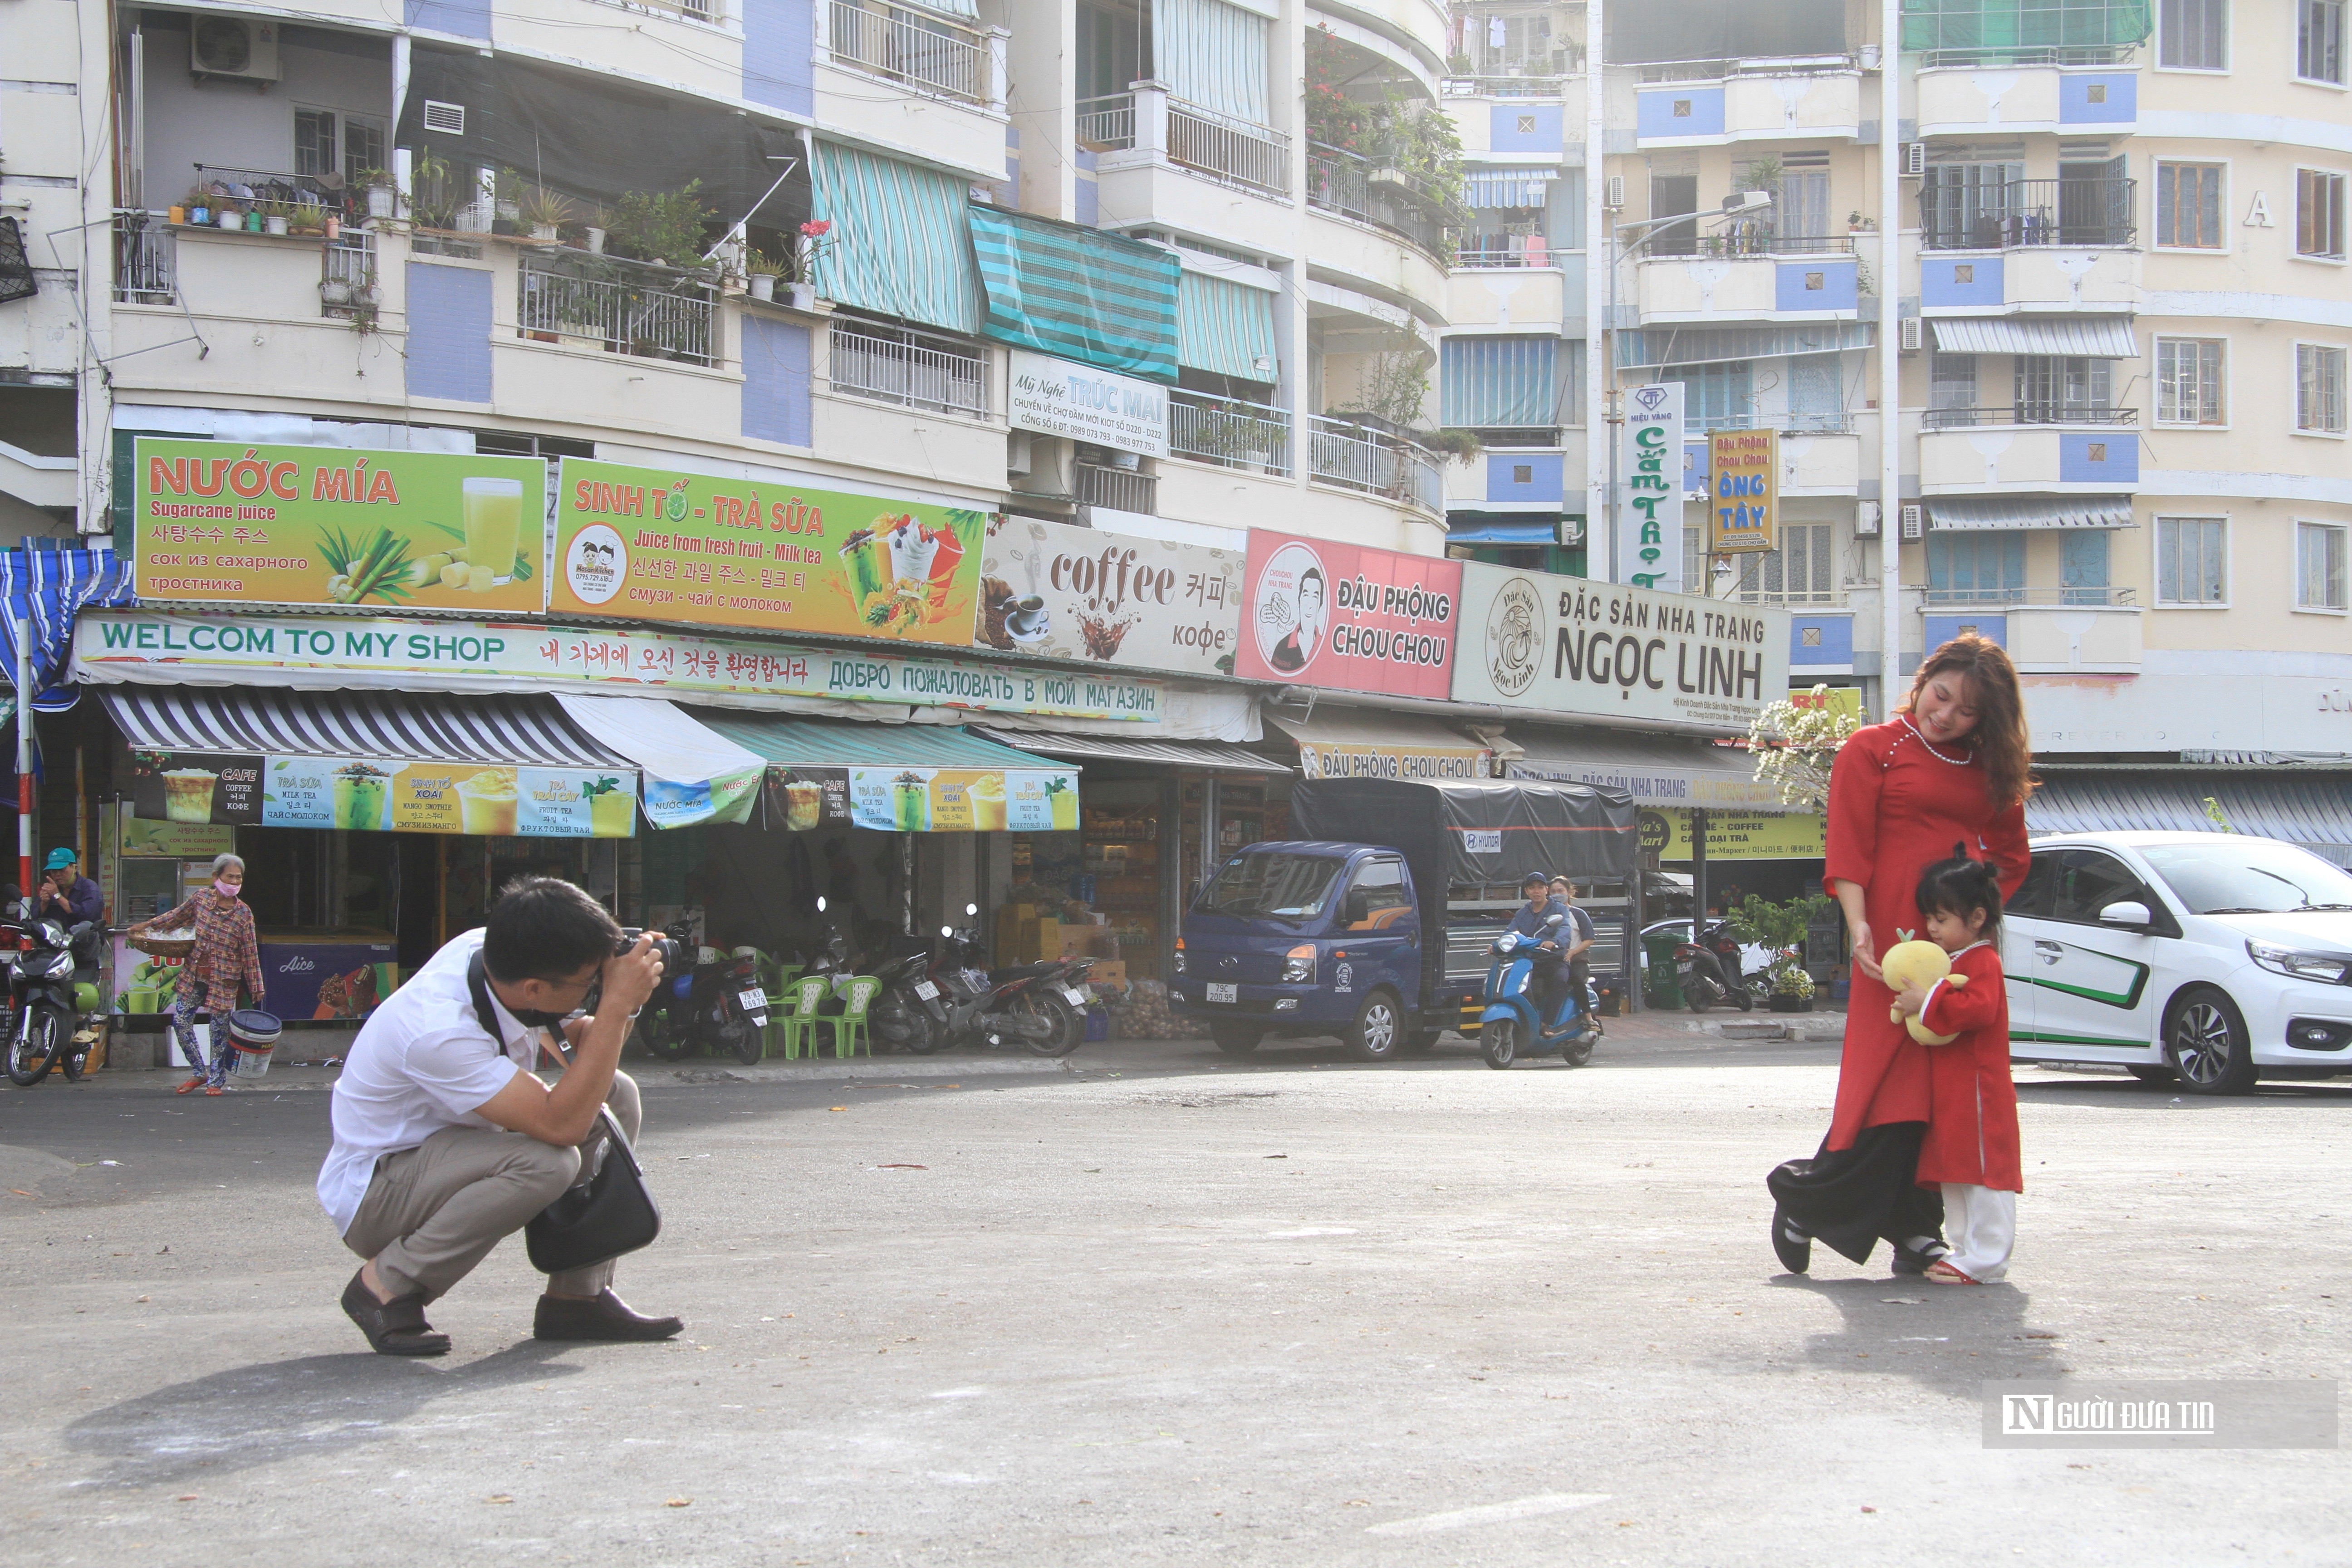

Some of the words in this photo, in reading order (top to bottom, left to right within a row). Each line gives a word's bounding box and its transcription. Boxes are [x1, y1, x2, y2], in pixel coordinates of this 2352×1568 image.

[2243, 190, 2275, 228] A
[1015, 374, 1035, 394] Mỹ
[1038, 380, 1066, 400] Nghệ
[1068, 376, 1117, 413] TRÚC
[1123, 389, 1161, 424] MAI
[1014, 397, 1042, 412] CHUYỂN
[1044, 402, 1052, 413] VỀ
[1053, 407, 1067, 418] CHỢ
[1069, 408, 1084, 420] ĐẦM
[1086, 413, 1099, 424] MỚI
[1101, 418, 1114, 427] KIOT
[1116, 418, 1124, 430] SỐ
[1126, 423, 1141, 434] D220
[1147, 428, 1161, 439] D222
[1631, 412, 1648, 423] HIỆU
[1652, 411, 1672, 419] VÀNG
[1042, 416, 1051, 427] SỐ
[1059, 422, 1069, 431] ĐT:
[1070, 425, 1085, 435] 0989
[1087, 429, 1098, 438] 073
[1099, 432, 1110, 440] 793
[1116, 435, 1130, 446] 0983
[1132, 439, 1143, 448] 977
[1144, 442, 1155, 451] 753
[1717, 438, 1735, 451] Đậu
[1739, 436, 1768, 450] Phộng
[1717, 456, 1741, 466] Chou
[1744, 454, 1768, 465] Chou
[148, 448, 299, 501] NƯỚC
[311, 458, 399, 505] MÍA
[1719, 471, 1765, 497] ÔNG
[151, 501, 233, 518] Sugarcane
[237, 504, 276, 520] juice
[573, 479, 644, 517] SINH
[713, 490, 763, 532] TRÀ
[770, 498, 824, 536] SỮA
[1719, 501, 1766, 529] TÂY
[151, 525, 225, 543] 사탕수수
[233, 527, 268, 544] 주스
[634, 530, 668, 549] Juice
[673, 534, 701, 553] from
[705, 536, 735, 556] fresh
[739, 540, 763, 559] fruit
[774, 543, 799, 562] Milk
[804, 547, 821, 564] tea
[150, 554, 181, 565] сок
[189, 555, 209, 566] из
[216, 556, 308, 571] сахарного
[632, 558, 677, 578] 신선한
[682, 561, 711, 583] 과일
[718, 564, 745, 585] 주스
[761, 568, 786, 588] 밀크
[793, 572, 806, 591] 티
[1050, 544, 1176, 614] coffee
[149, 578, 243, 593] тростника
[1185, 573, 1226, 610] 커피
[1268, 579, 1278, 588] NHA
[1279, 581, 1293, 590] TRANG
[629, 587, 674, 605] смузи
[688, 589, 713, 606] чай
[730, 597, 792, 613] молоком
[1338, 575, 1379, 618] ĐẬU
[1383, 583, 1450, 625] PHỘNG
[1503, 591, 1519, 607] Đặc
[1521, 590, 1534, 613] Sản
[1559, 587, 1600, 627] ĐẶC
[1610, 593, 1648, 628] SẢN
[1657, 606, 1695, 635] NHA
[1705, 612, 1764, 644] TRANG
[102, 622, 274, 653] WELCOM
[284, 628, 336, 656] TO
[345, 632, 399, 659] MY
[407, 634, 506, 663] SHOP
[1173, 621, 1226, 656] кофе
[540, 638, 559, 667] 내
[568, 640, 629, 671] 가게에
[638, 647, 676, 676] 오신
[683, 648, 720, 679] 것을
[725, 652, 809, 685] 환영합니다
[1554, 627, 1666, 700] NGỌC
[1678, 642, 1761, 700] LINH
[1492, 657, 1510, 688] Ngọc
[1513, 663, 1534, 689] Linh
[829, 661, 891, 691] ДОБРО
[903, 666, 1014, 701] ПОЖАЛОВАТЬ
[1025, 679, 1035, 702] В
[1045, 676, 1076, 705] МОЙ
[1086, 684, 1155, 711] МАГАЗИН
[1729, 704, 1740, 714] Trang
[222, 769, 257, 781] CAFE
[278, 775, 297, 788] TRÀ
[299, 777, 322, 789] SỮA
[410, 778, 435, 788] SINH
[437, 776, 451, 789] TỐ
[549, 779, 566, 790] TRÀ
[415, 788, 443, 799] XOÀI
[722, 779, 748, 792] Nước
[823, 780, 845, 791] CAFE
[1631, 777, 1651, 797] NHA
[1655, 778, 1686, 798] TRANG
[230, 793, 245, 801] 커피
[533, 789, 556, 801] TRÁI
[558, 790, 579, 802] CÂY
[655, 800, 682, 810] NƯỚC
[685, 799, 702, 808] MÍA
[1727, 823, 1764, 831] COFFEE
[279, 956, 315, 973] Aice
[1210, 993, 1233, 1002] 200.95
[1216, 984, 1228, 992] 79C
[744, 997, 765, 1008] 269.79
